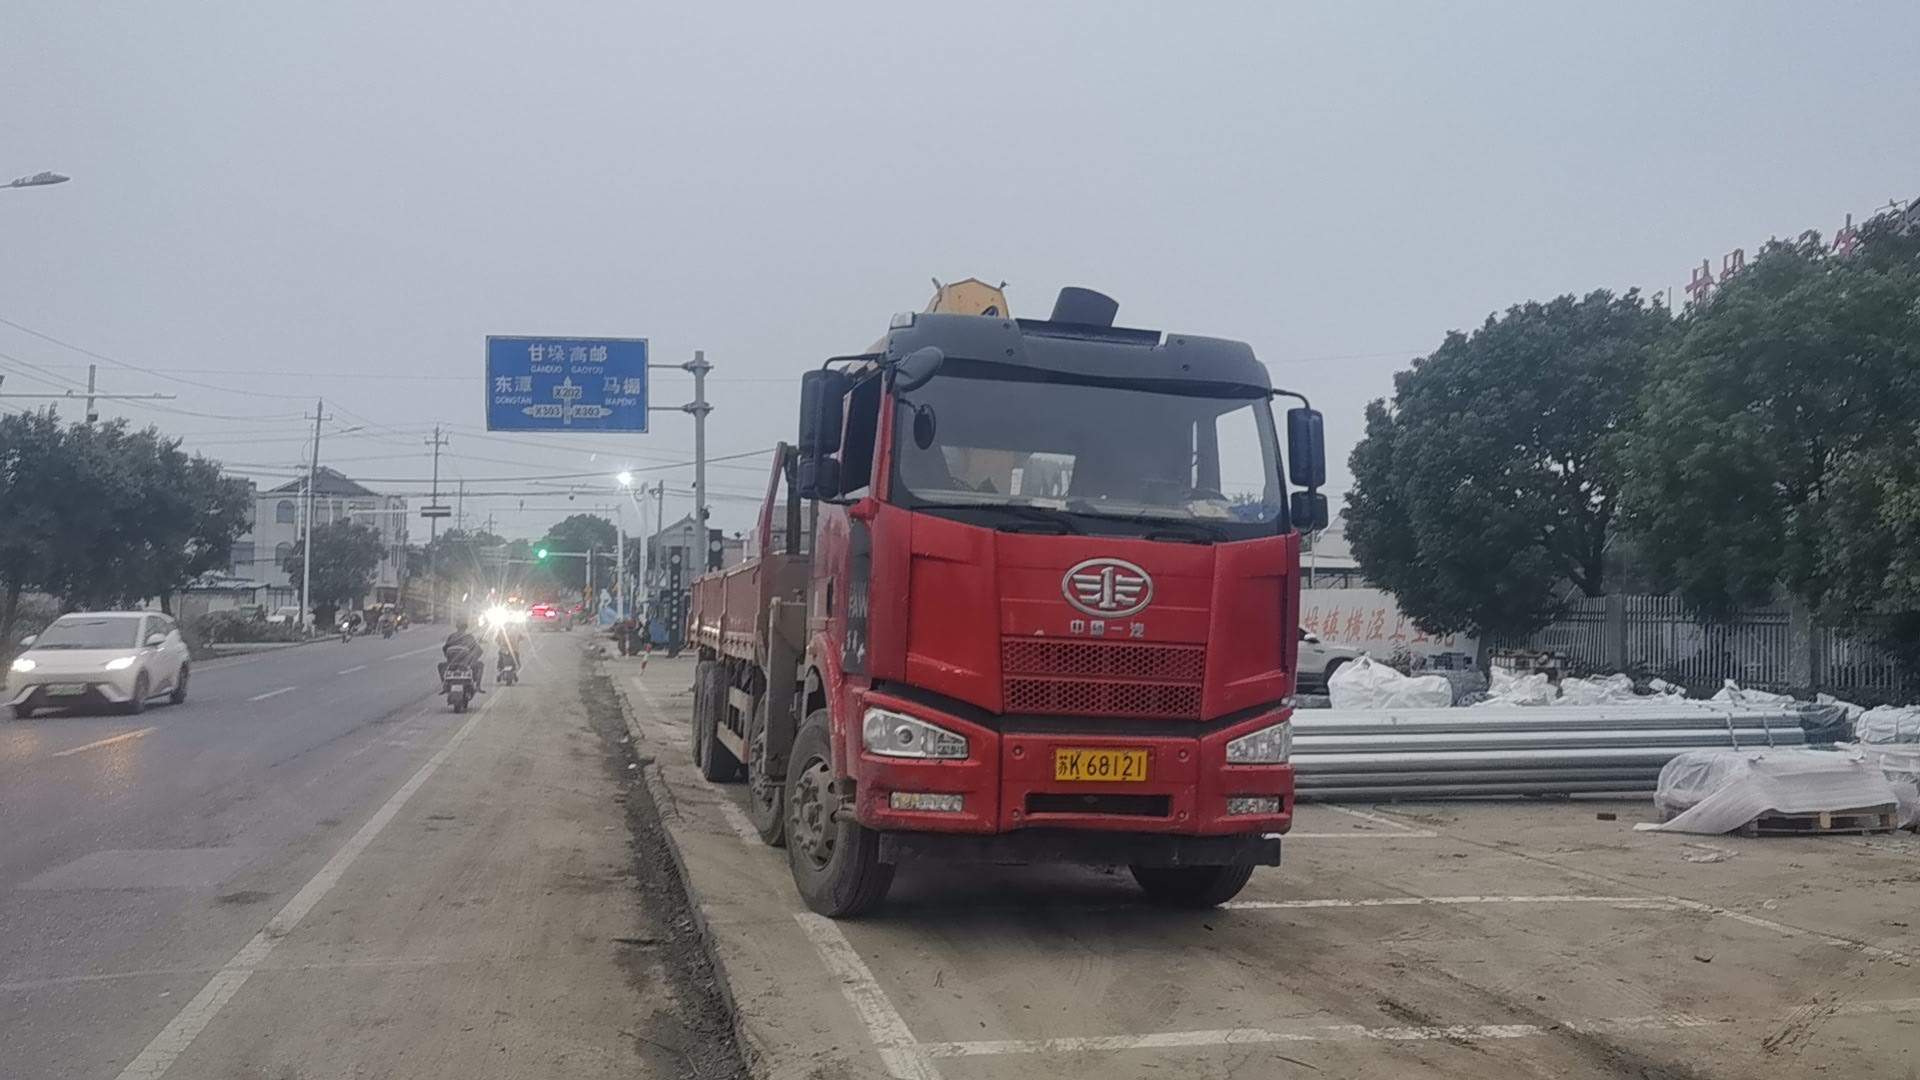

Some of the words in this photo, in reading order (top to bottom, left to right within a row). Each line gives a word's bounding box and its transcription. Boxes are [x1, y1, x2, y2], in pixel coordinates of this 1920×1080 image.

[528, 344, 565, 362] 甘垛
[569, 345, 608, 363] 高邮
[1070, 619, 1145, 638] 中国一汽
